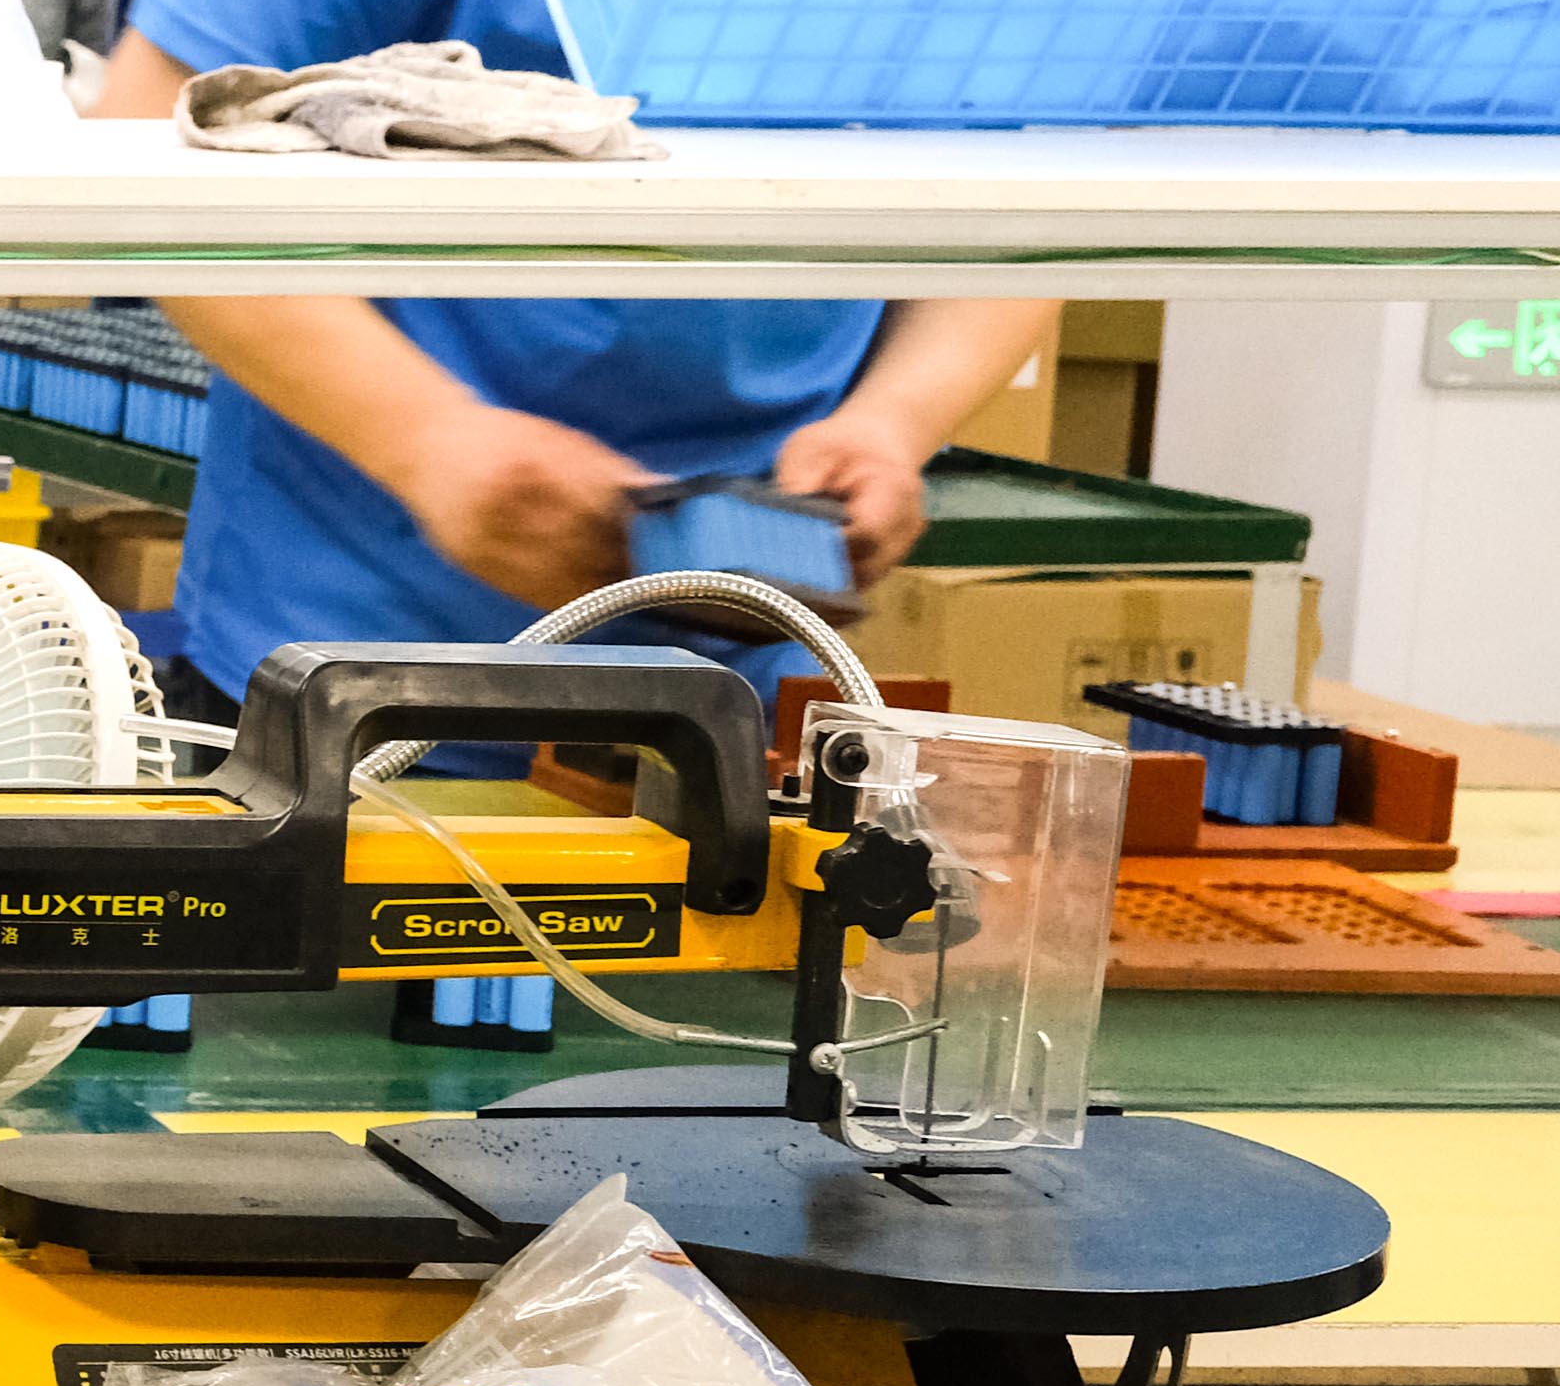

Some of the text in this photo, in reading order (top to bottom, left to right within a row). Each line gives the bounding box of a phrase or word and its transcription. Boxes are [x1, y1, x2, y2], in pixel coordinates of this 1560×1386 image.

[182, 896, 228, 918] Pro
[537, 910, 624, 934] Saw
[0, 926, 161, 947] 洛克士
